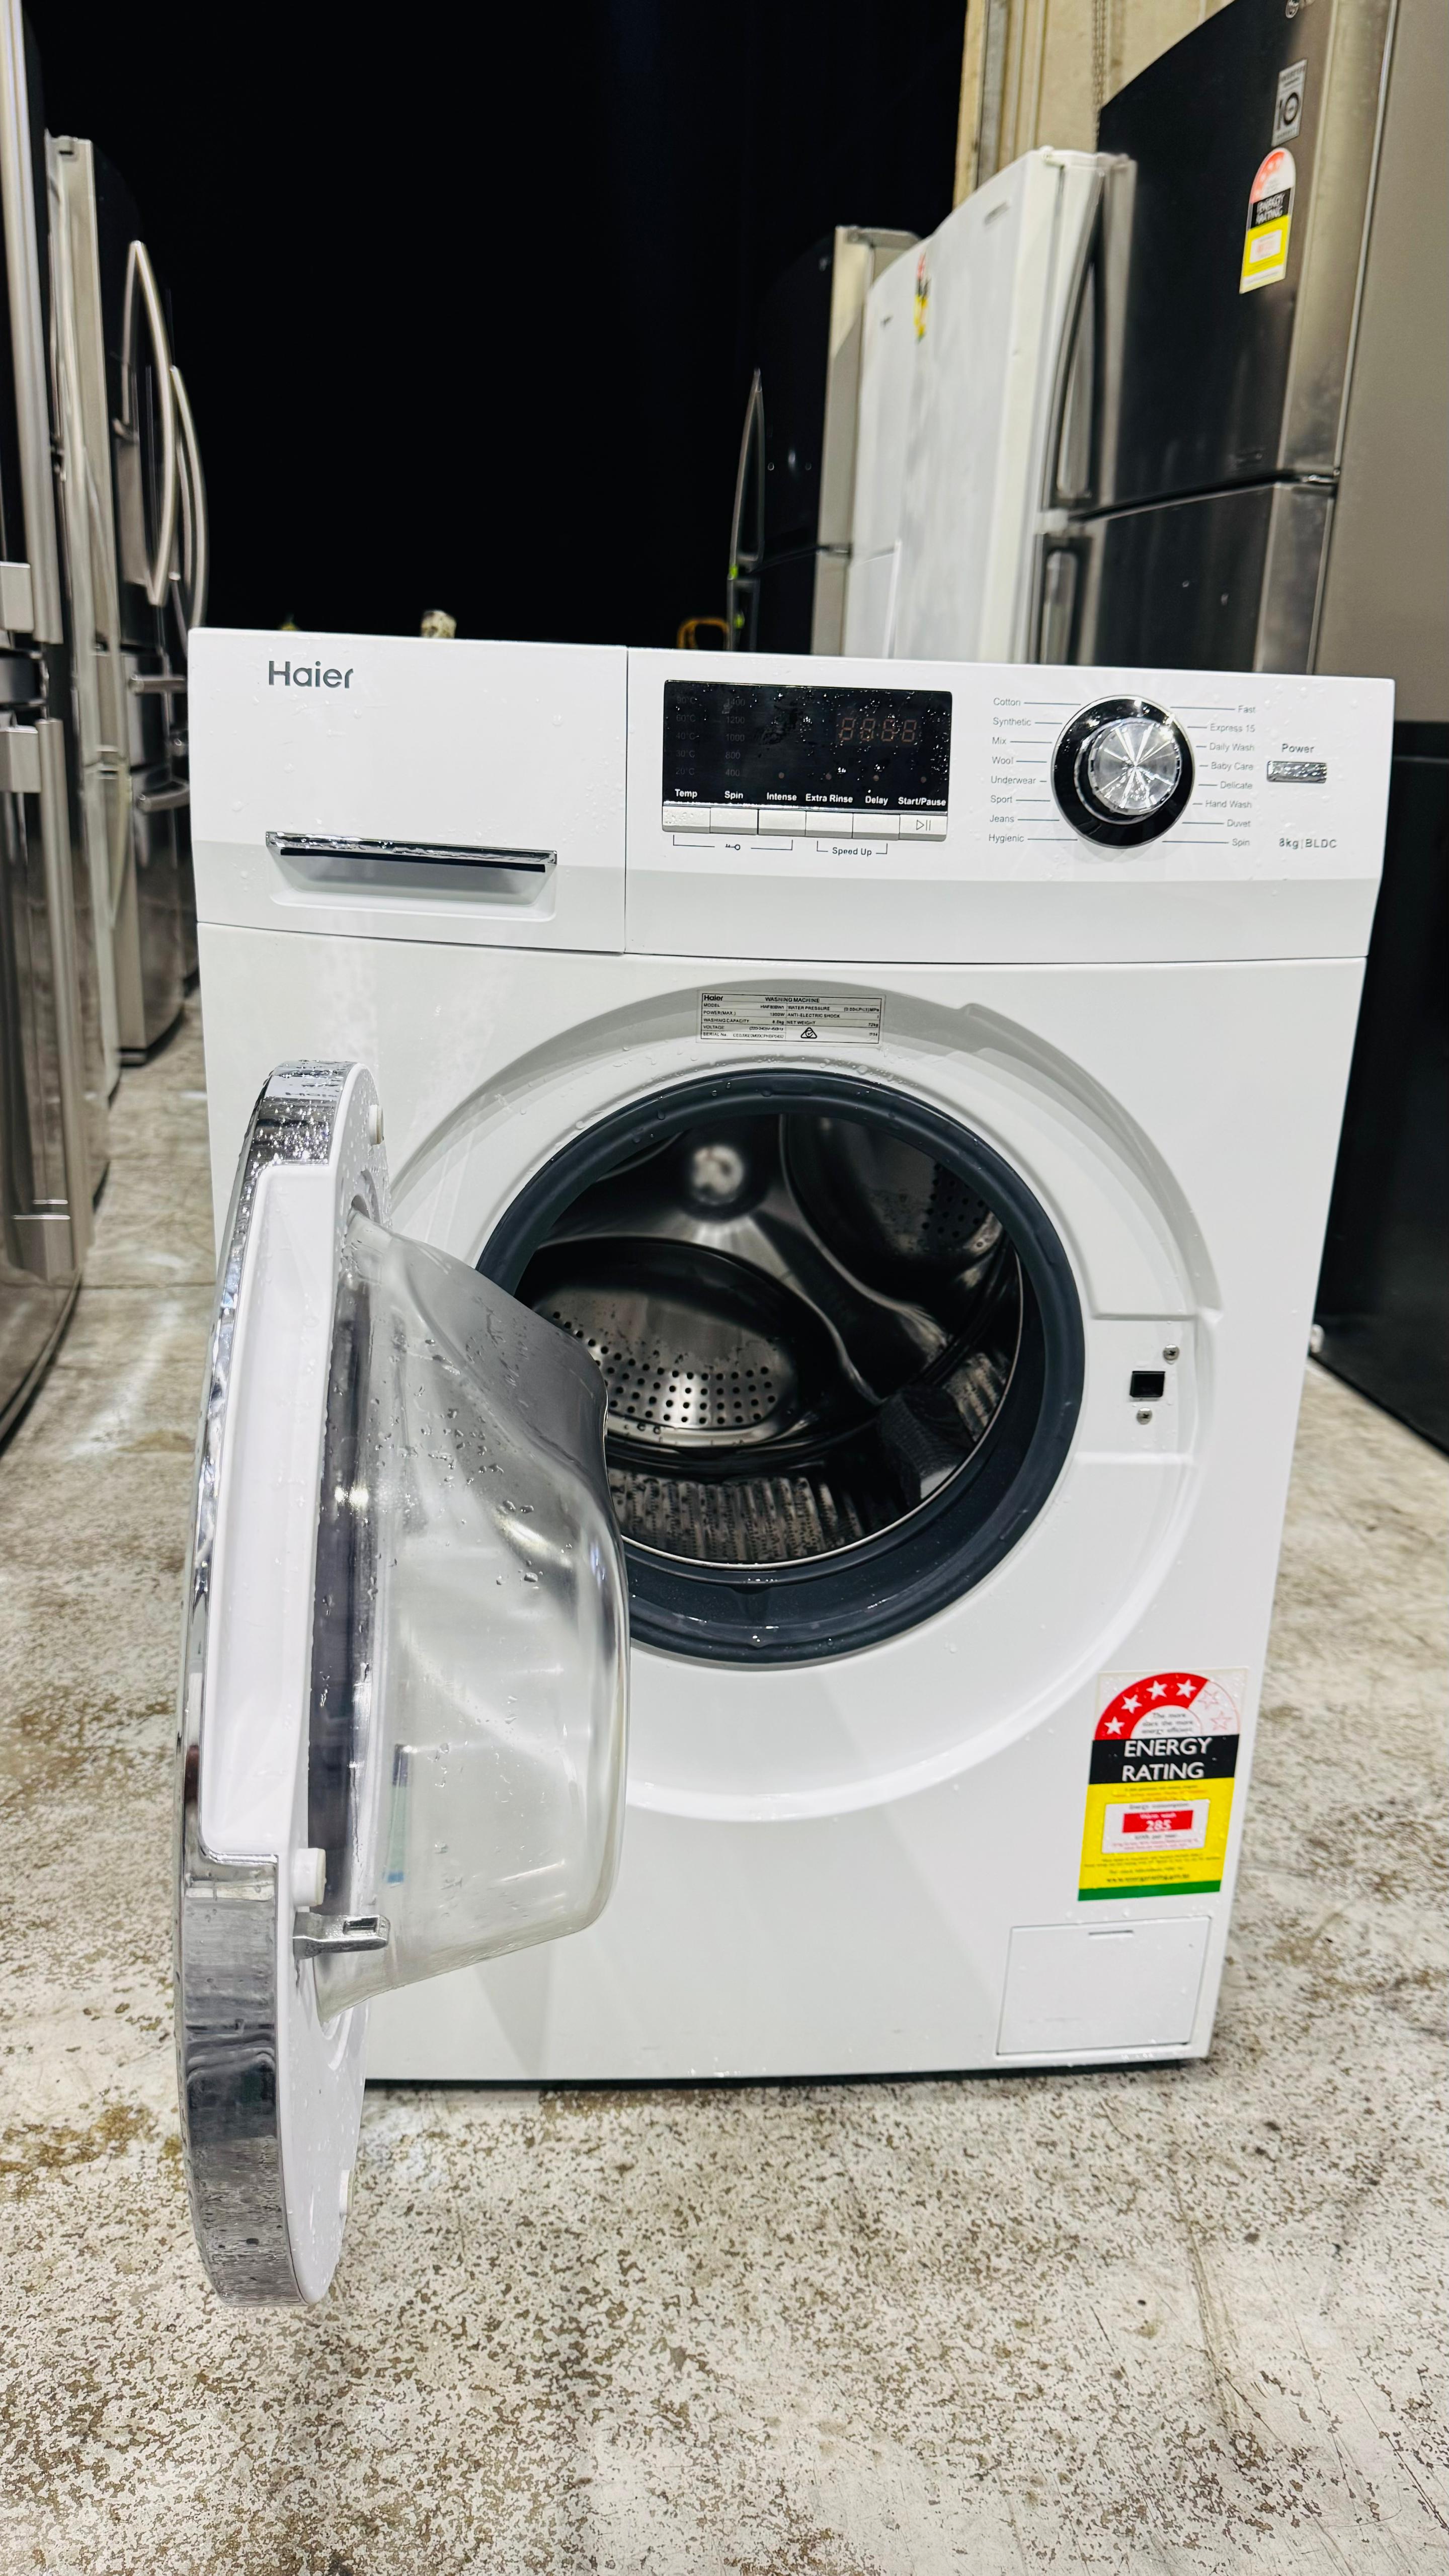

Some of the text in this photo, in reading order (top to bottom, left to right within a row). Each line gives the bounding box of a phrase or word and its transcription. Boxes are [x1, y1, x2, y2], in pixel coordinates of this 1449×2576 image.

[269, 660, 354, 689] Haier
[993, 697, 1021, 706] Cotton
[1238, 705, 1256, 713] Fast
[993, 717, 1032, 728] Synthetic
[1210, 723, 1256, 733] Express 15
[992, 737, 1007, 745] Mix
[1209, 742, 1255, 753] Daily Wash
[1281, 743, 1315, 753] Power
[992, 756, 1014, 765] Wool
[1211, 761, 1254, 772] Baby Care
[991, 775, 1036, 784] Underwear
[1220, 781, 1253, 789] Delicate
[675, 788, 698, 799] Temp
[724, 790, 744, 799] Spin
[766, 792, 797, 801] Intense
[806, 793, 853, 803] Extra Rinse
[865, 795, 889, 806] Delay
[898, 796, 946, 807] Start/Pause
[990, 795, 1013, 804] Sport
[1205, 800, 1252, 809] Hand Wash
[990, 815, 1014, 823] Jeans
[1227, 819, 1251, 828] Duvet
[989, 833, 1024, 844] Hygienic
[1232, 838, 1250, 847] Spin
[832, 847, 872, 857] Speed Up
[1124, 1737, 1213, 1757] ENERGY
[1121, 1761, 1205, 1782] RATING
[1145, 1819, 1172, 1832] 285
